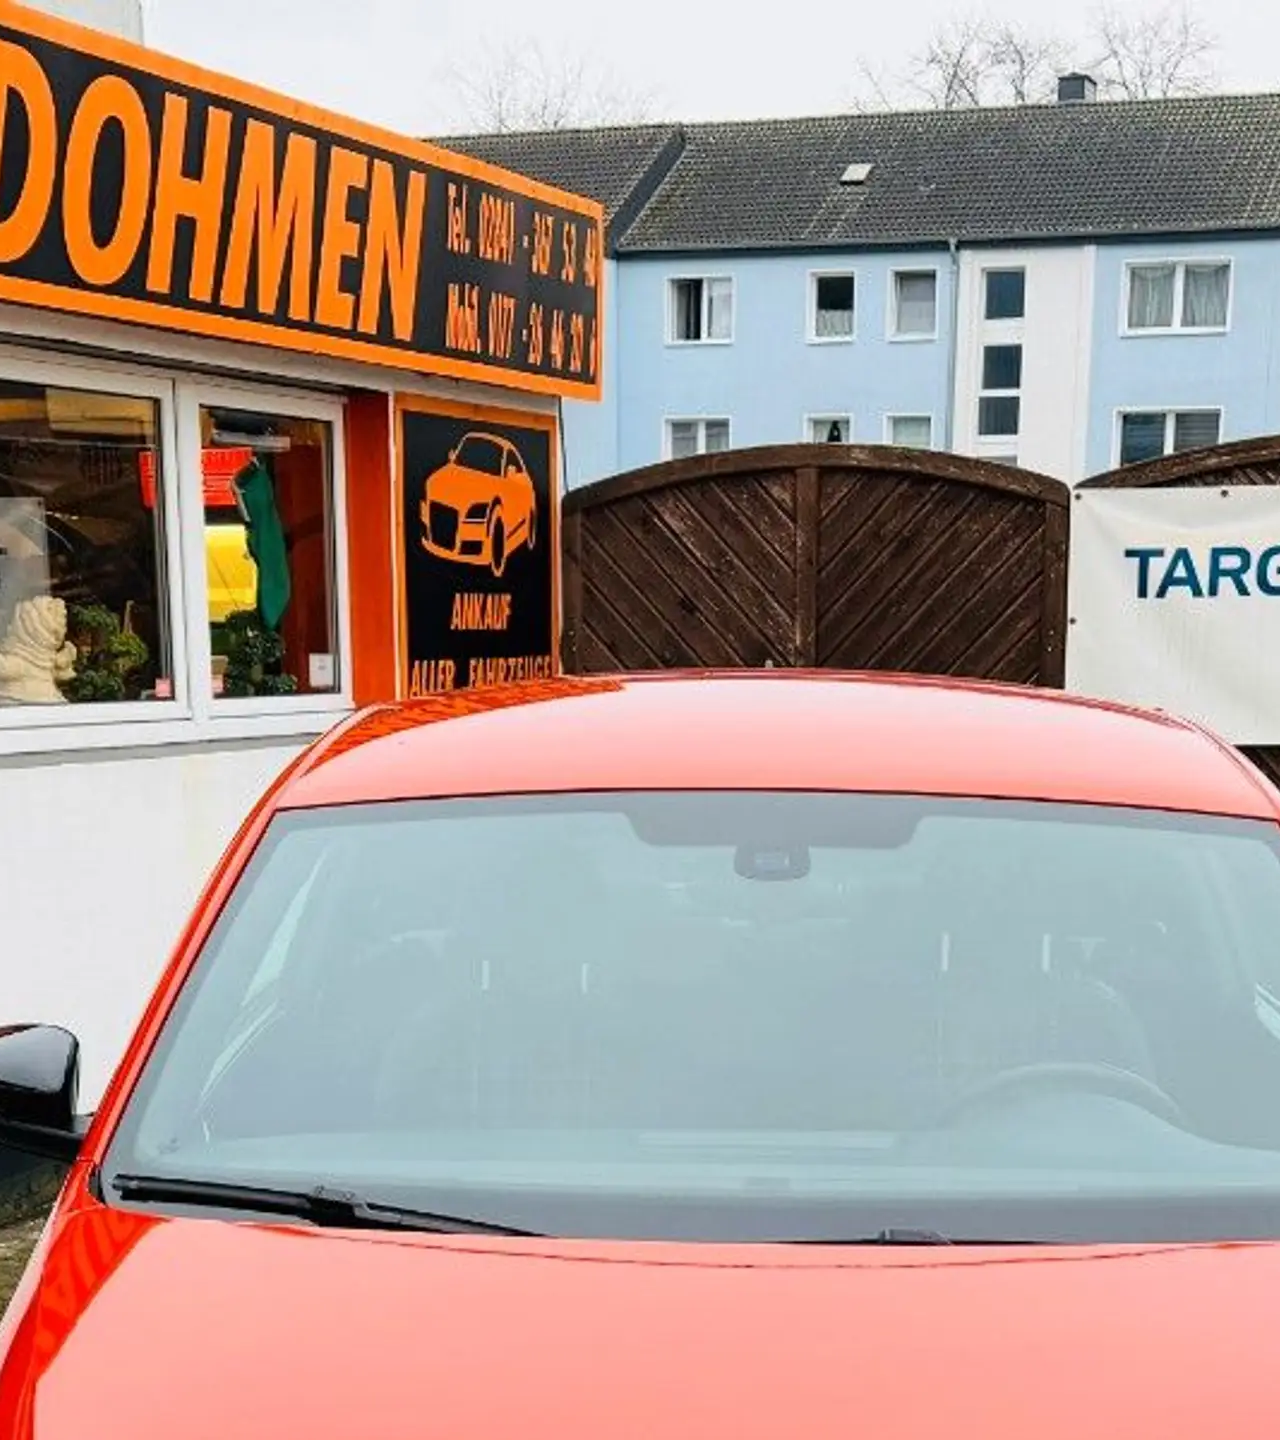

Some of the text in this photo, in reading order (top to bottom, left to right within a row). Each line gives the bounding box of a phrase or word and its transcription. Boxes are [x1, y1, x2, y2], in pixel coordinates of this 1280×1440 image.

[447, 181, 470, 254] Tel.
[450, 592, 512, 630] ANKAUF
[410, 655, 552, 697] ALLER FAHRZEUGE
